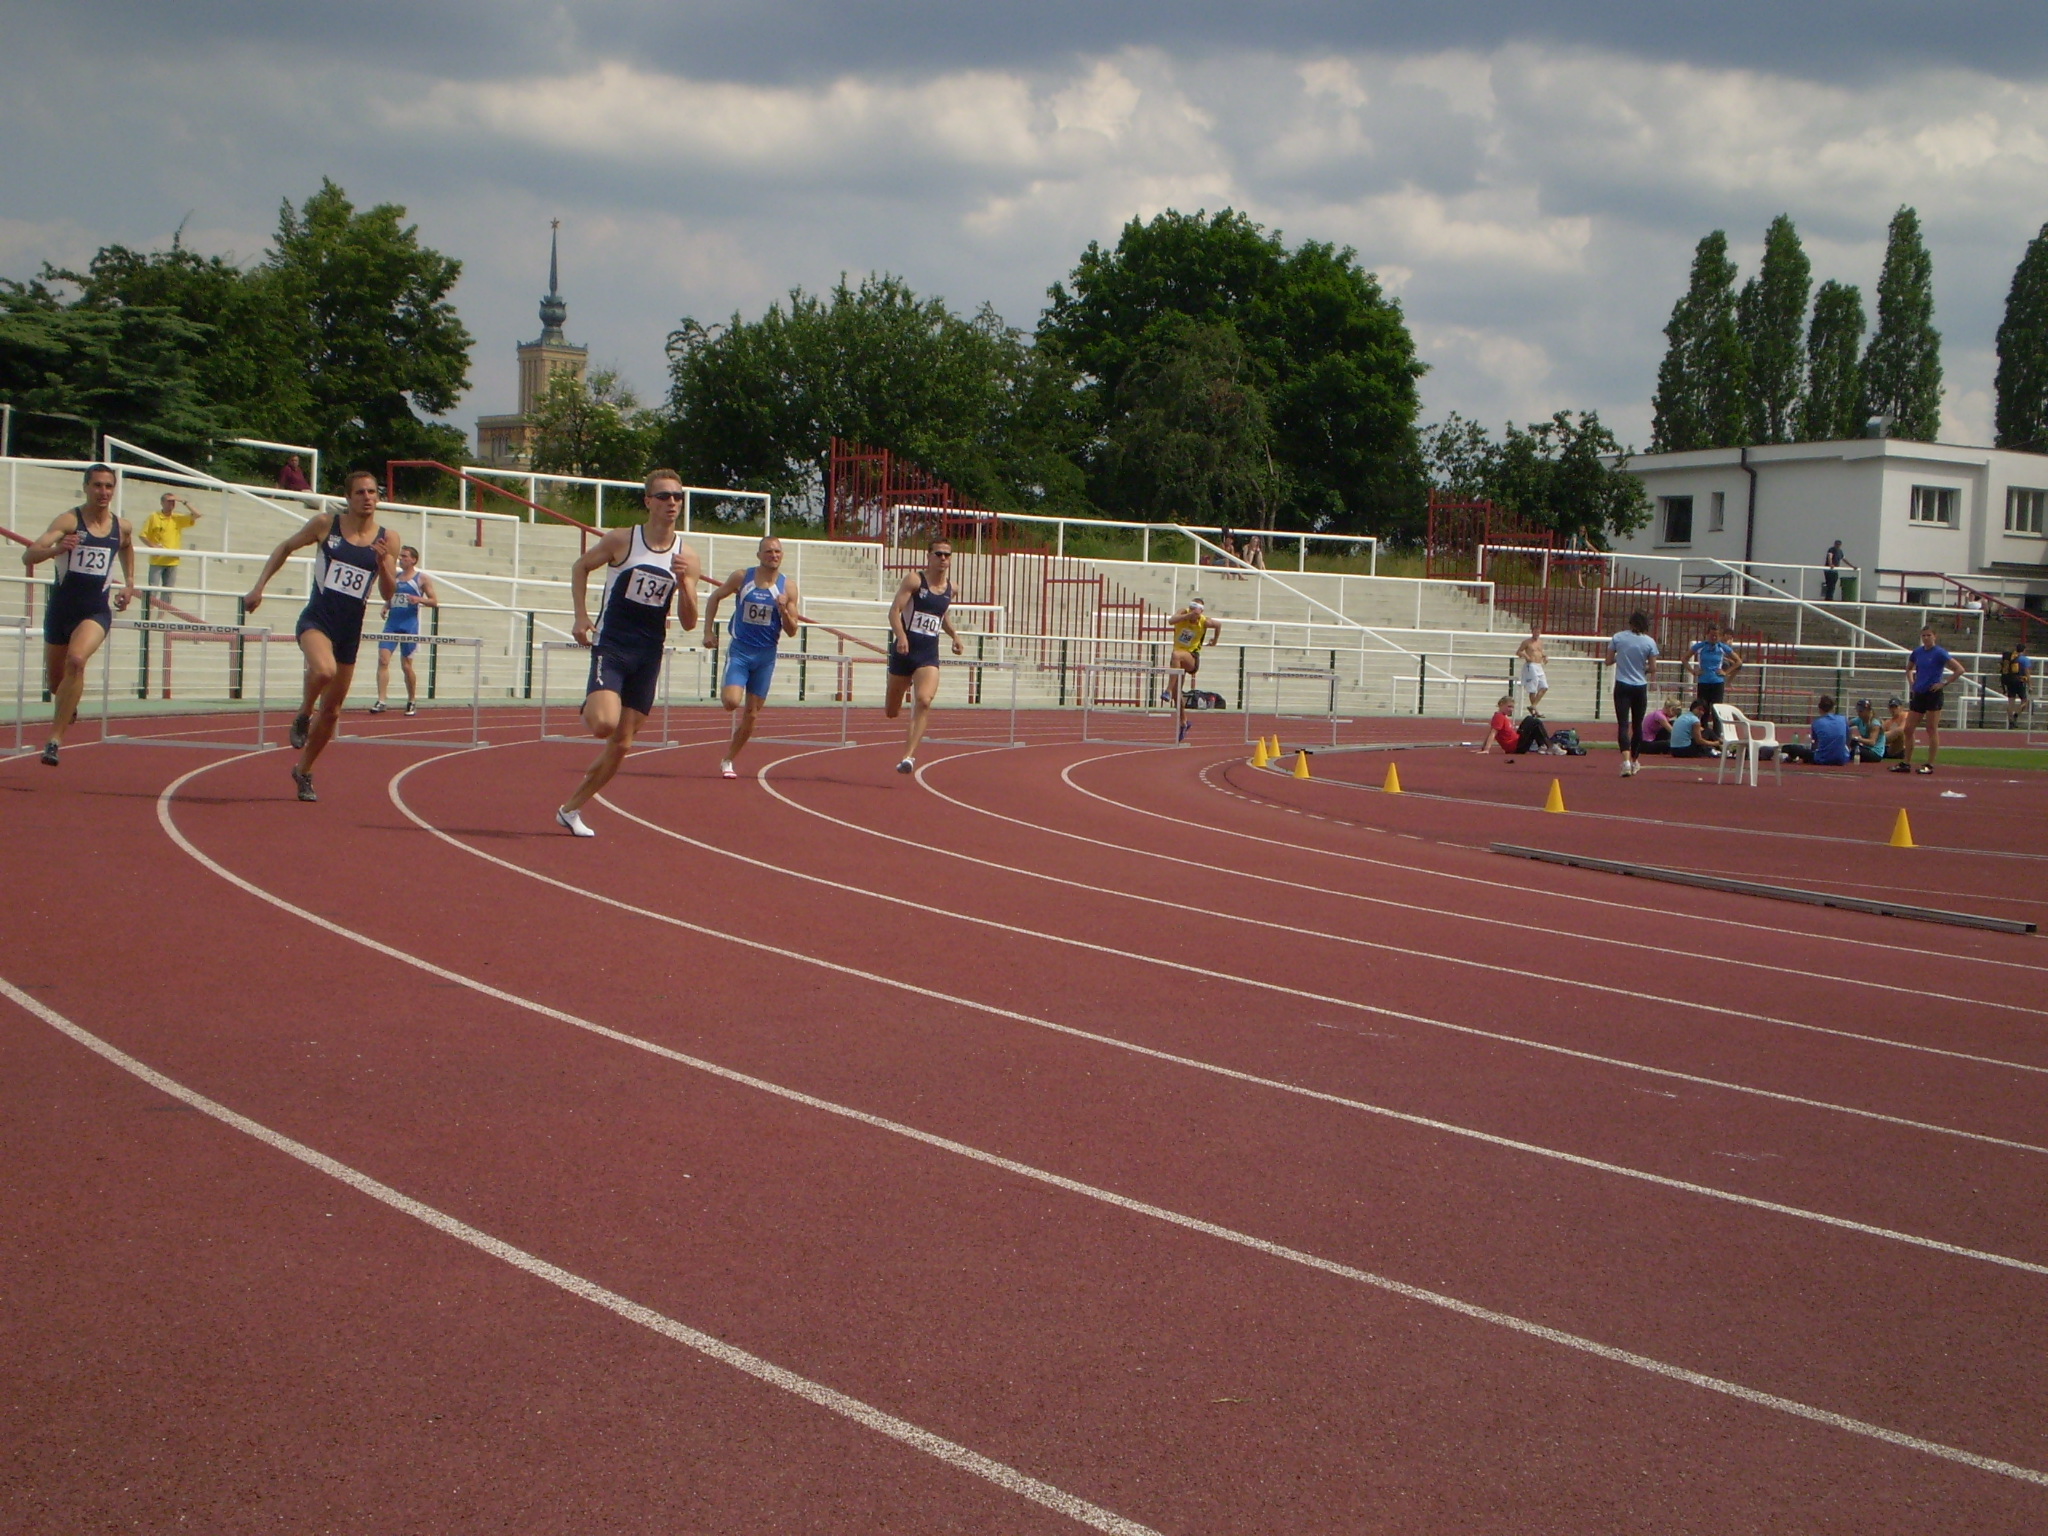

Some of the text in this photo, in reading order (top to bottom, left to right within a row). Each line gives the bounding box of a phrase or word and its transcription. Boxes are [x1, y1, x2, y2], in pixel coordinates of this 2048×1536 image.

[77, 550, 105, 569] 123
[333, 567, 364, 590] 138
[636, 577, 667, 600] 134
[749, 604, 767, 620] 64
[134, 622, 240, 633] NORDICSPORT.COM
[917, 615, 936, 631] 140
[362, 633, 456, 643] NORDICSPORT.COM
